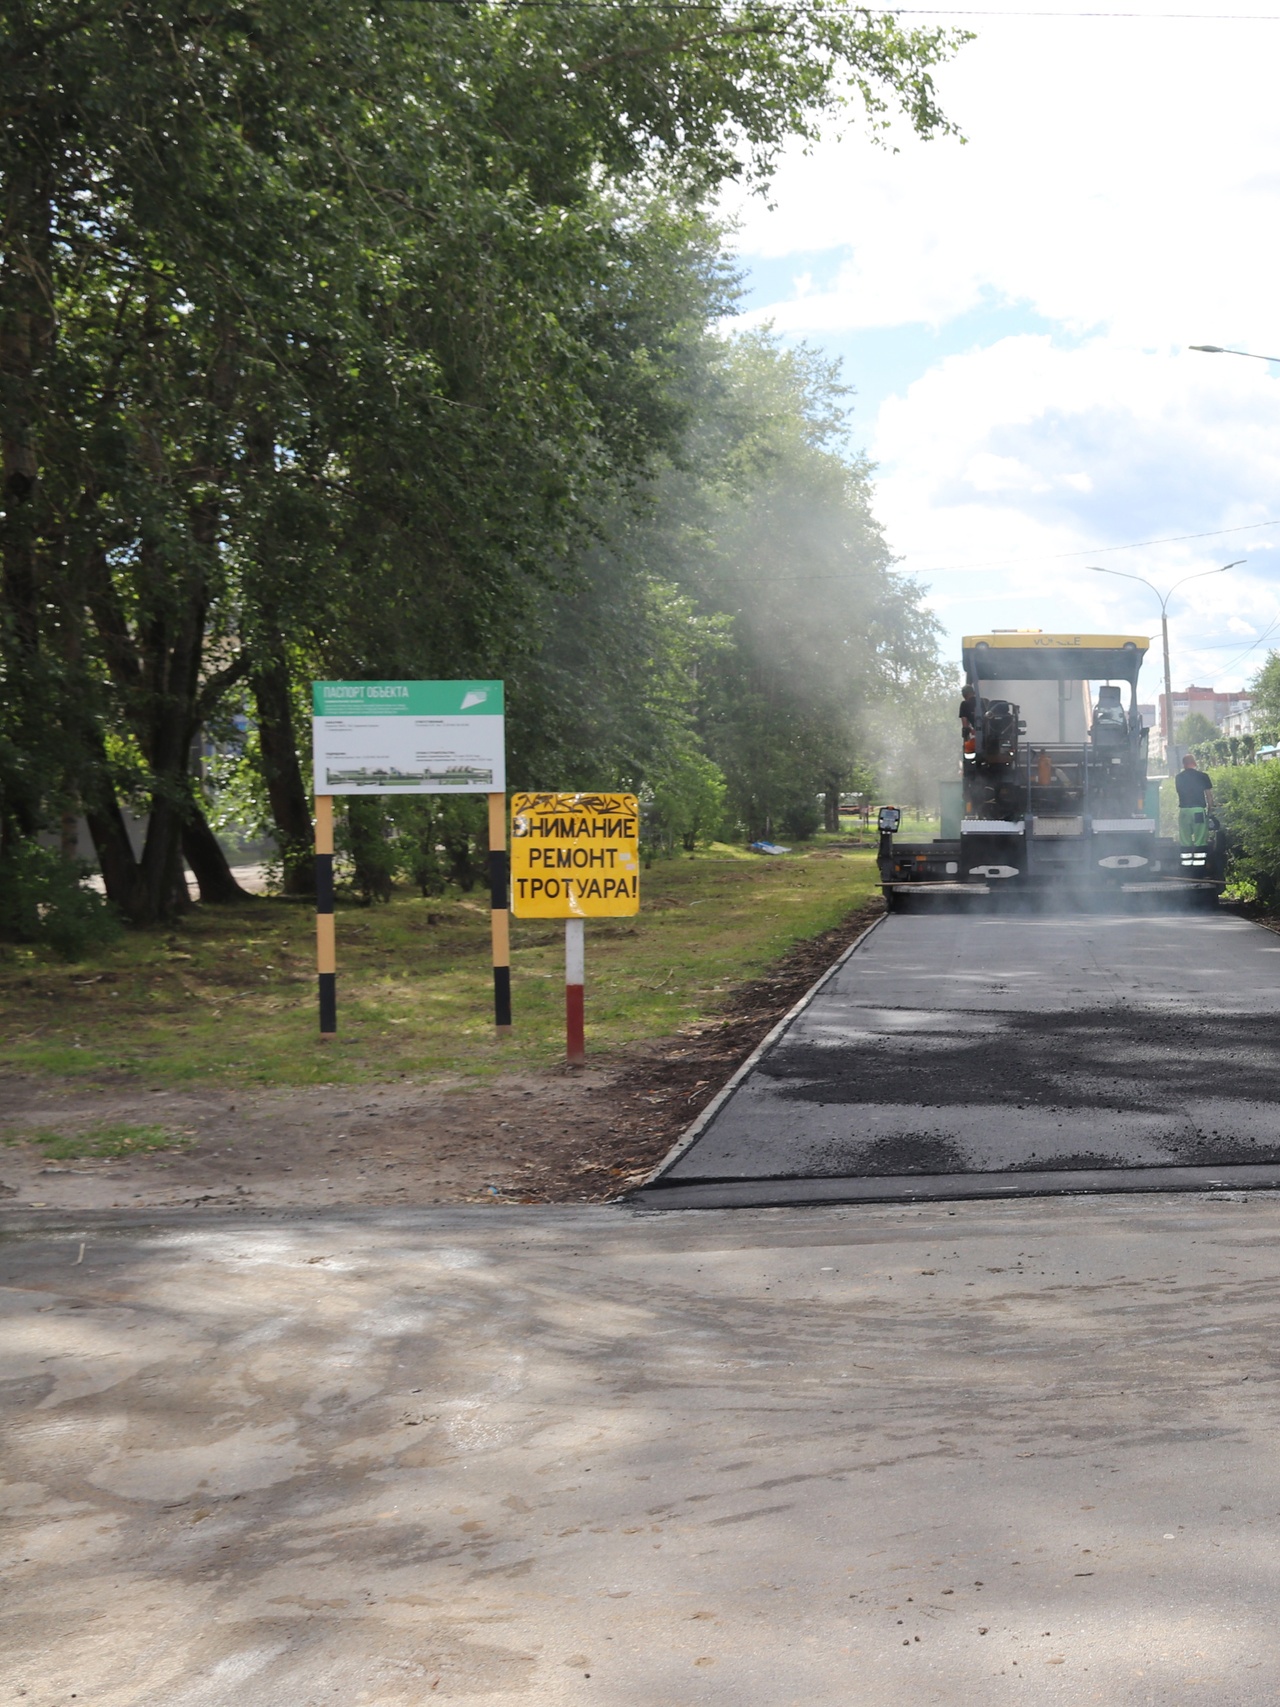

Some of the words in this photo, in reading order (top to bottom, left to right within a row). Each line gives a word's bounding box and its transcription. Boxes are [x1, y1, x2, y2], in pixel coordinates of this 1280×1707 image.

[323, 686, 365, 698] ПАСПОРТ
[367, 686, 409, 697] ОБЪЕКТА
[513, 818, 635, 838] ВНИМАНИЕ
[529, 848, 618, 868] РЕМОНТ
[517, 876, 637, 898] ТРОТУАРА!
